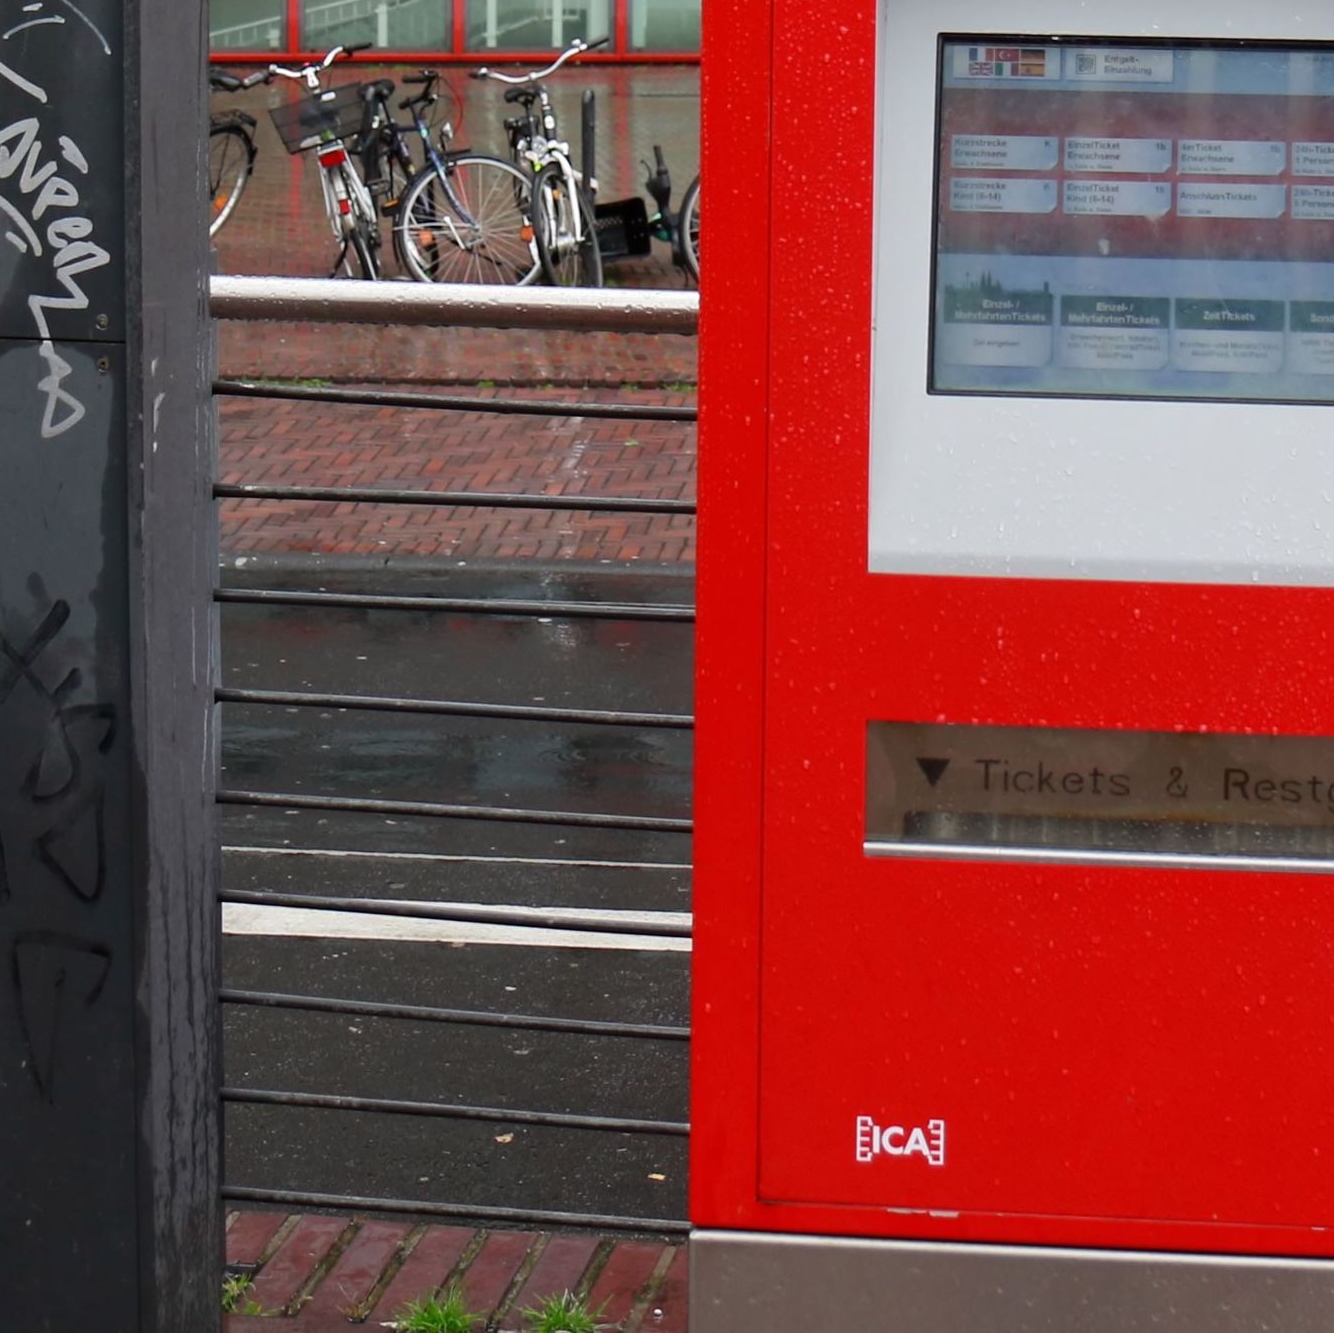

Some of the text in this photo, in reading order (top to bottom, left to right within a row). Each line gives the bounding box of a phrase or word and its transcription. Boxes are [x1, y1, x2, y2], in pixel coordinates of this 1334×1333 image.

[1103, 55, 1139, 66] Entgelt-
[1067, 141, 1120, 151] EinzelTicket
[1301, 157, 1334, 165] Person
[975, 758, 1132, 797] Tickets
[1166, 766, 1190, 799] &
[872, 1125, 930, 1156] ICA
